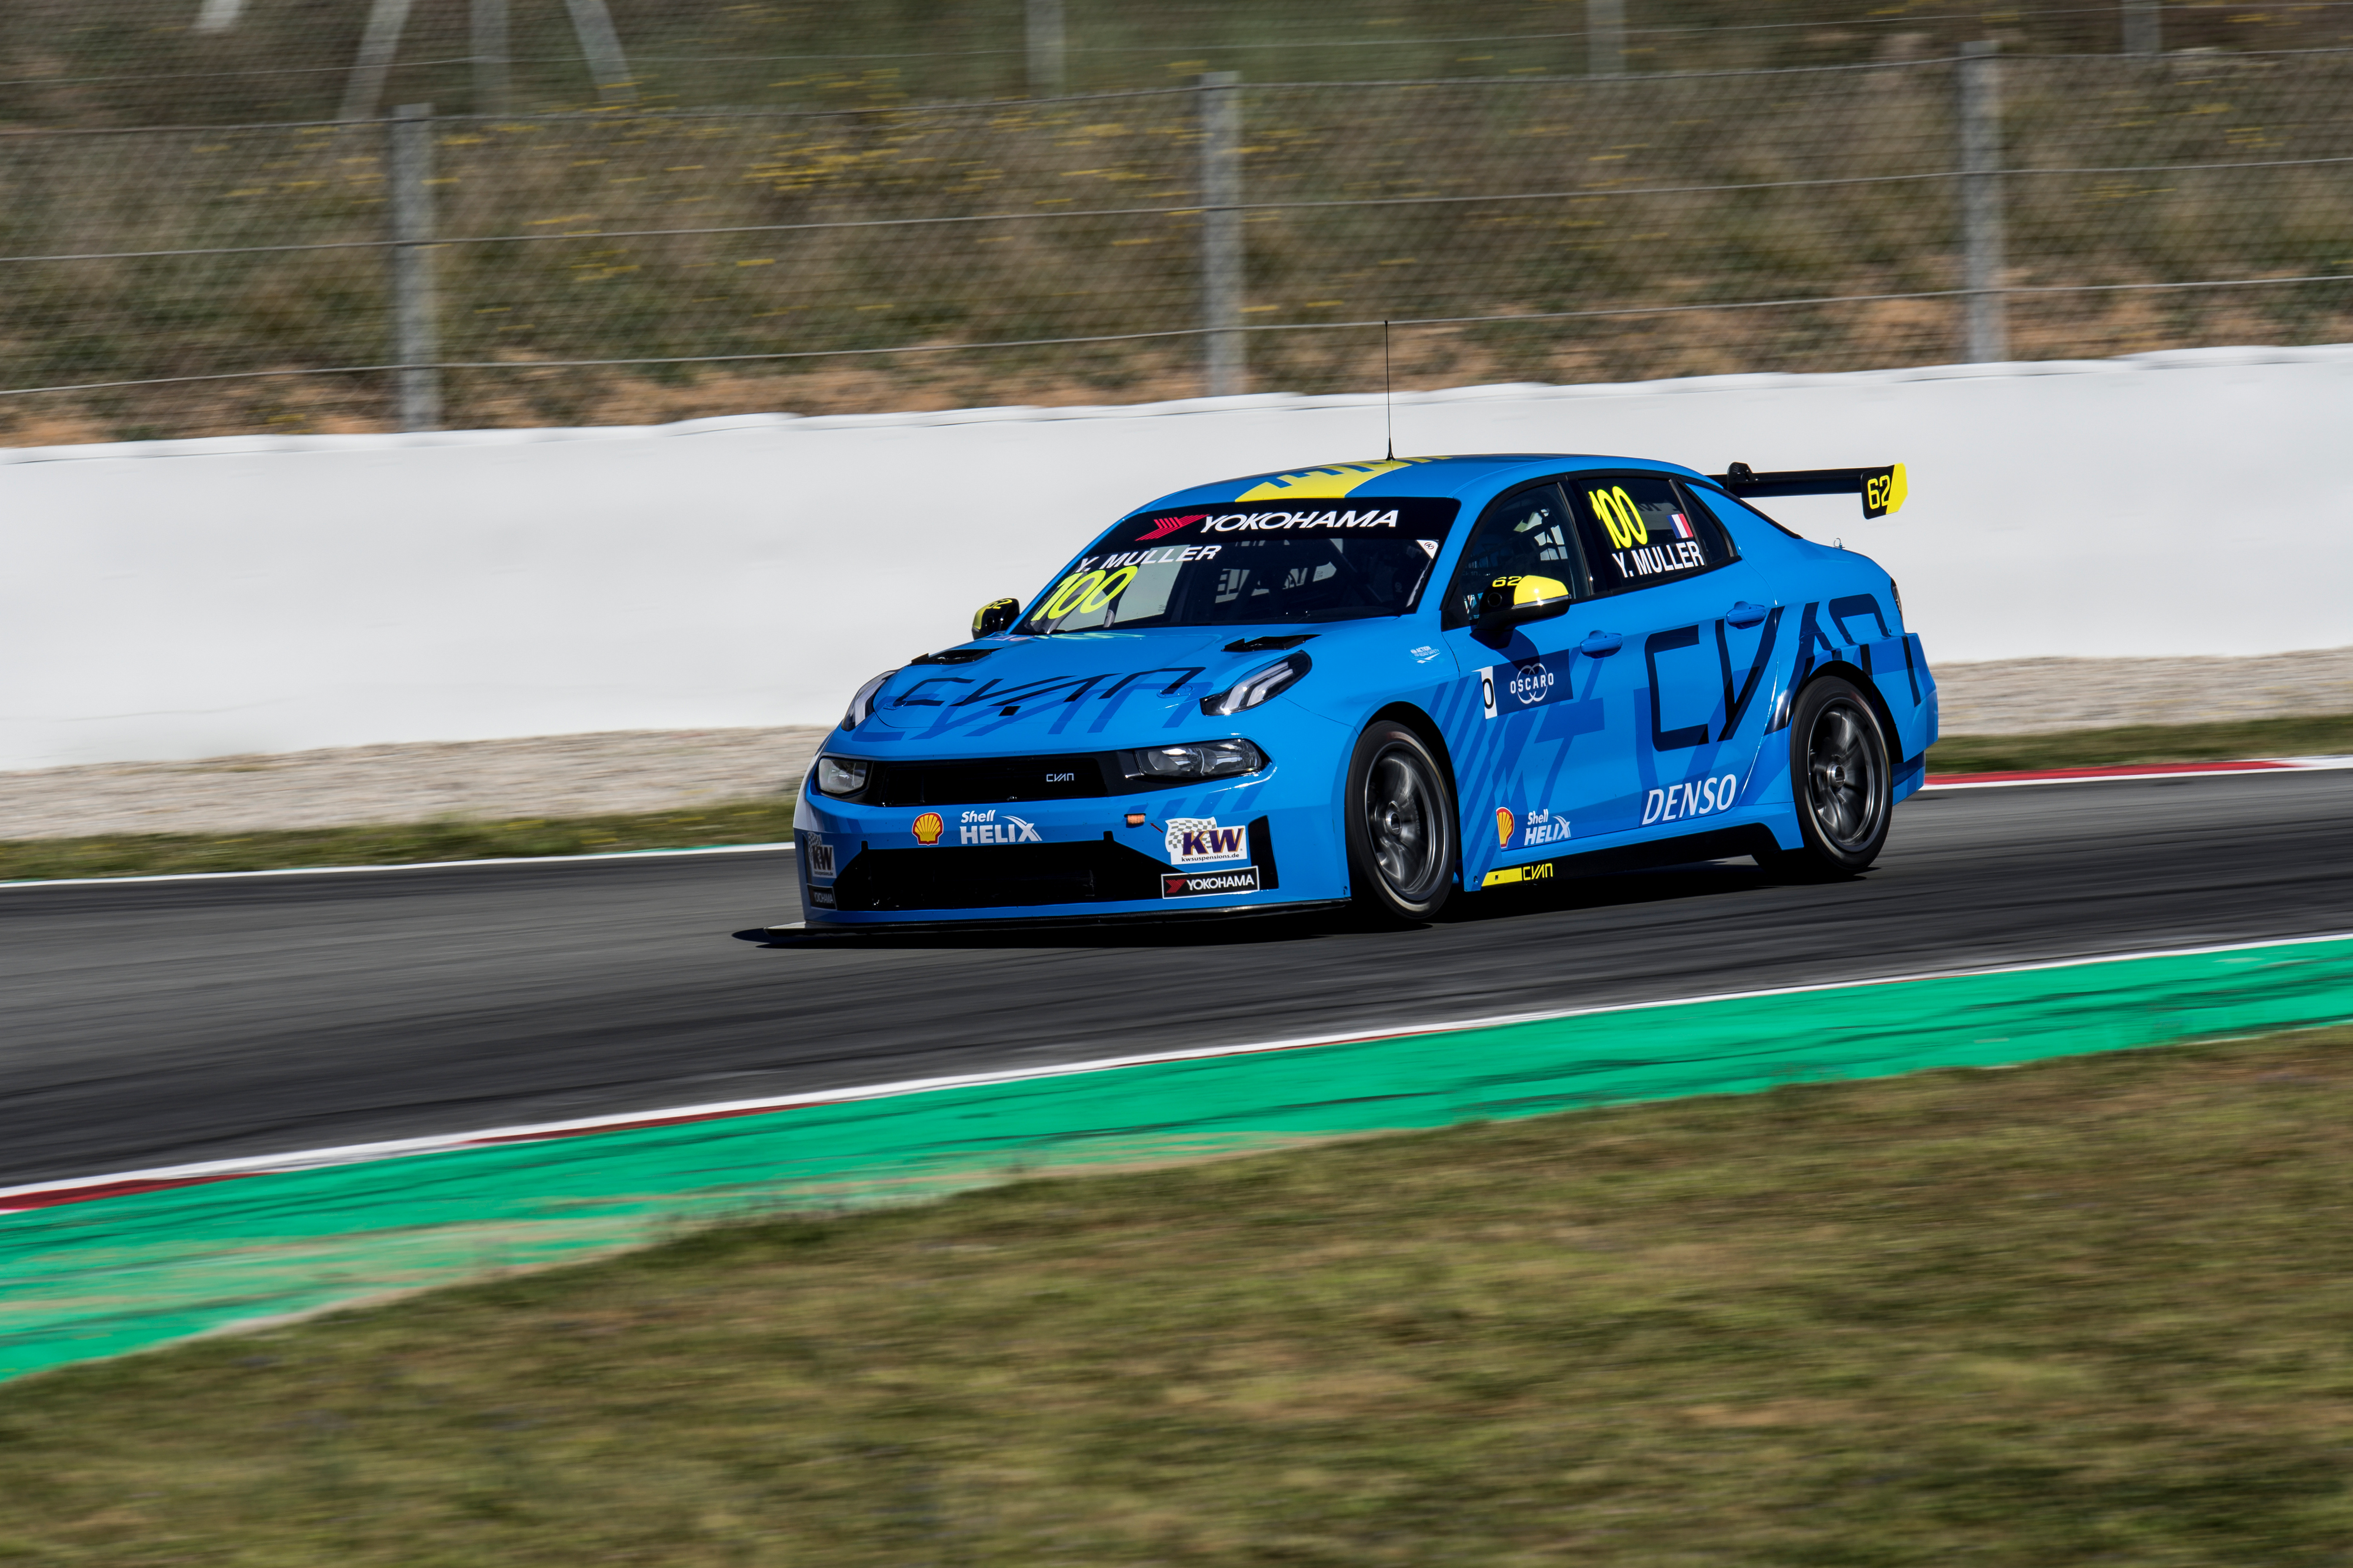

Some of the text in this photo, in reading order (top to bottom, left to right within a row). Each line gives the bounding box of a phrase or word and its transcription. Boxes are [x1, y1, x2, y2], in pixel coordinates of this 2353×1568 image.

[1867, 475, 1891, 510] 62
[1200, 509, 1399, 533] YOKOHAMA
[1588, 486, 1648, 549] 100
[1075, 545, 1222, 573] Y. MULLER
[1612, 541, 1705, 578] Y. MULLER
[1031, 565, 1138, 622] 100
[1492, 576, 1522, 588] 62
[1510, 672, 1555, 694] OSCARO
[1046, 773, 1074, 782] CYAN
[1641, 773, 1737, 825] DENSO
[961, 809, 996, 823] Shell
[1527, 808, 1549, 826] Shell
[959, 815, 1043, 845] HELIX
[1182, 828, 1245, 856] KW
[1524, 816, 1571, 846] HELIX
[812, 846, 833, 871] KW
[1181, 853, 1240, 862] kwsuspensions.de
[1186, 874, 1255, 891] YOKOHAMA
[1522, 863, 1554, 882] CYAN
